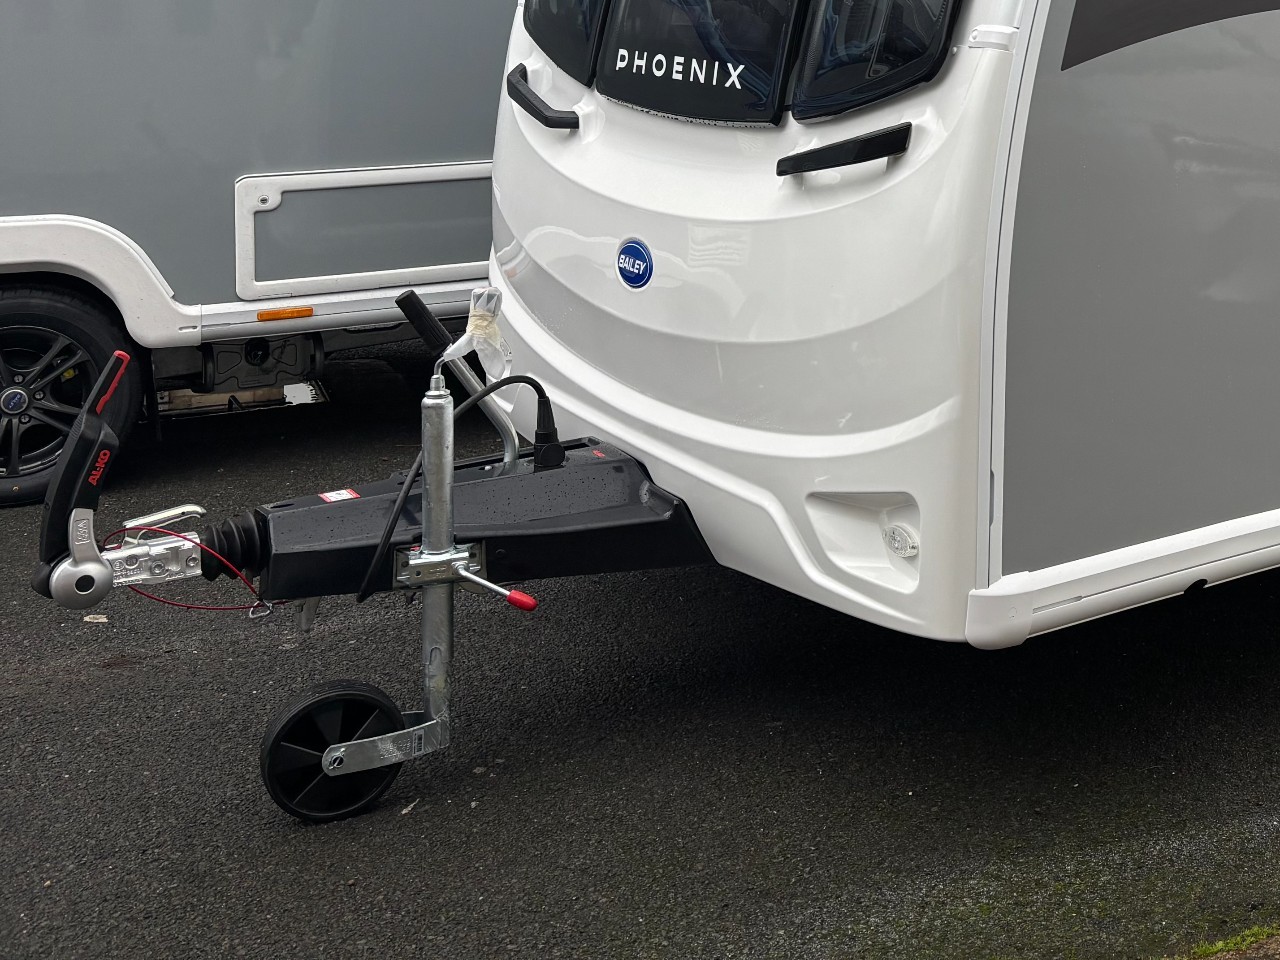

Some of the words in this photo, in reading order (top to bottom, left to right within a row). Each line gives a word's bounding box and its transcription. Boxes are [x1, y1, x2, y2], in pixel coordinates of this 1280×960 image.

[615, 48, 745, 90] PHOENIX
[618, 254, 647, 275] BAILEY
[88, 449, 111, 486] AL-KO
